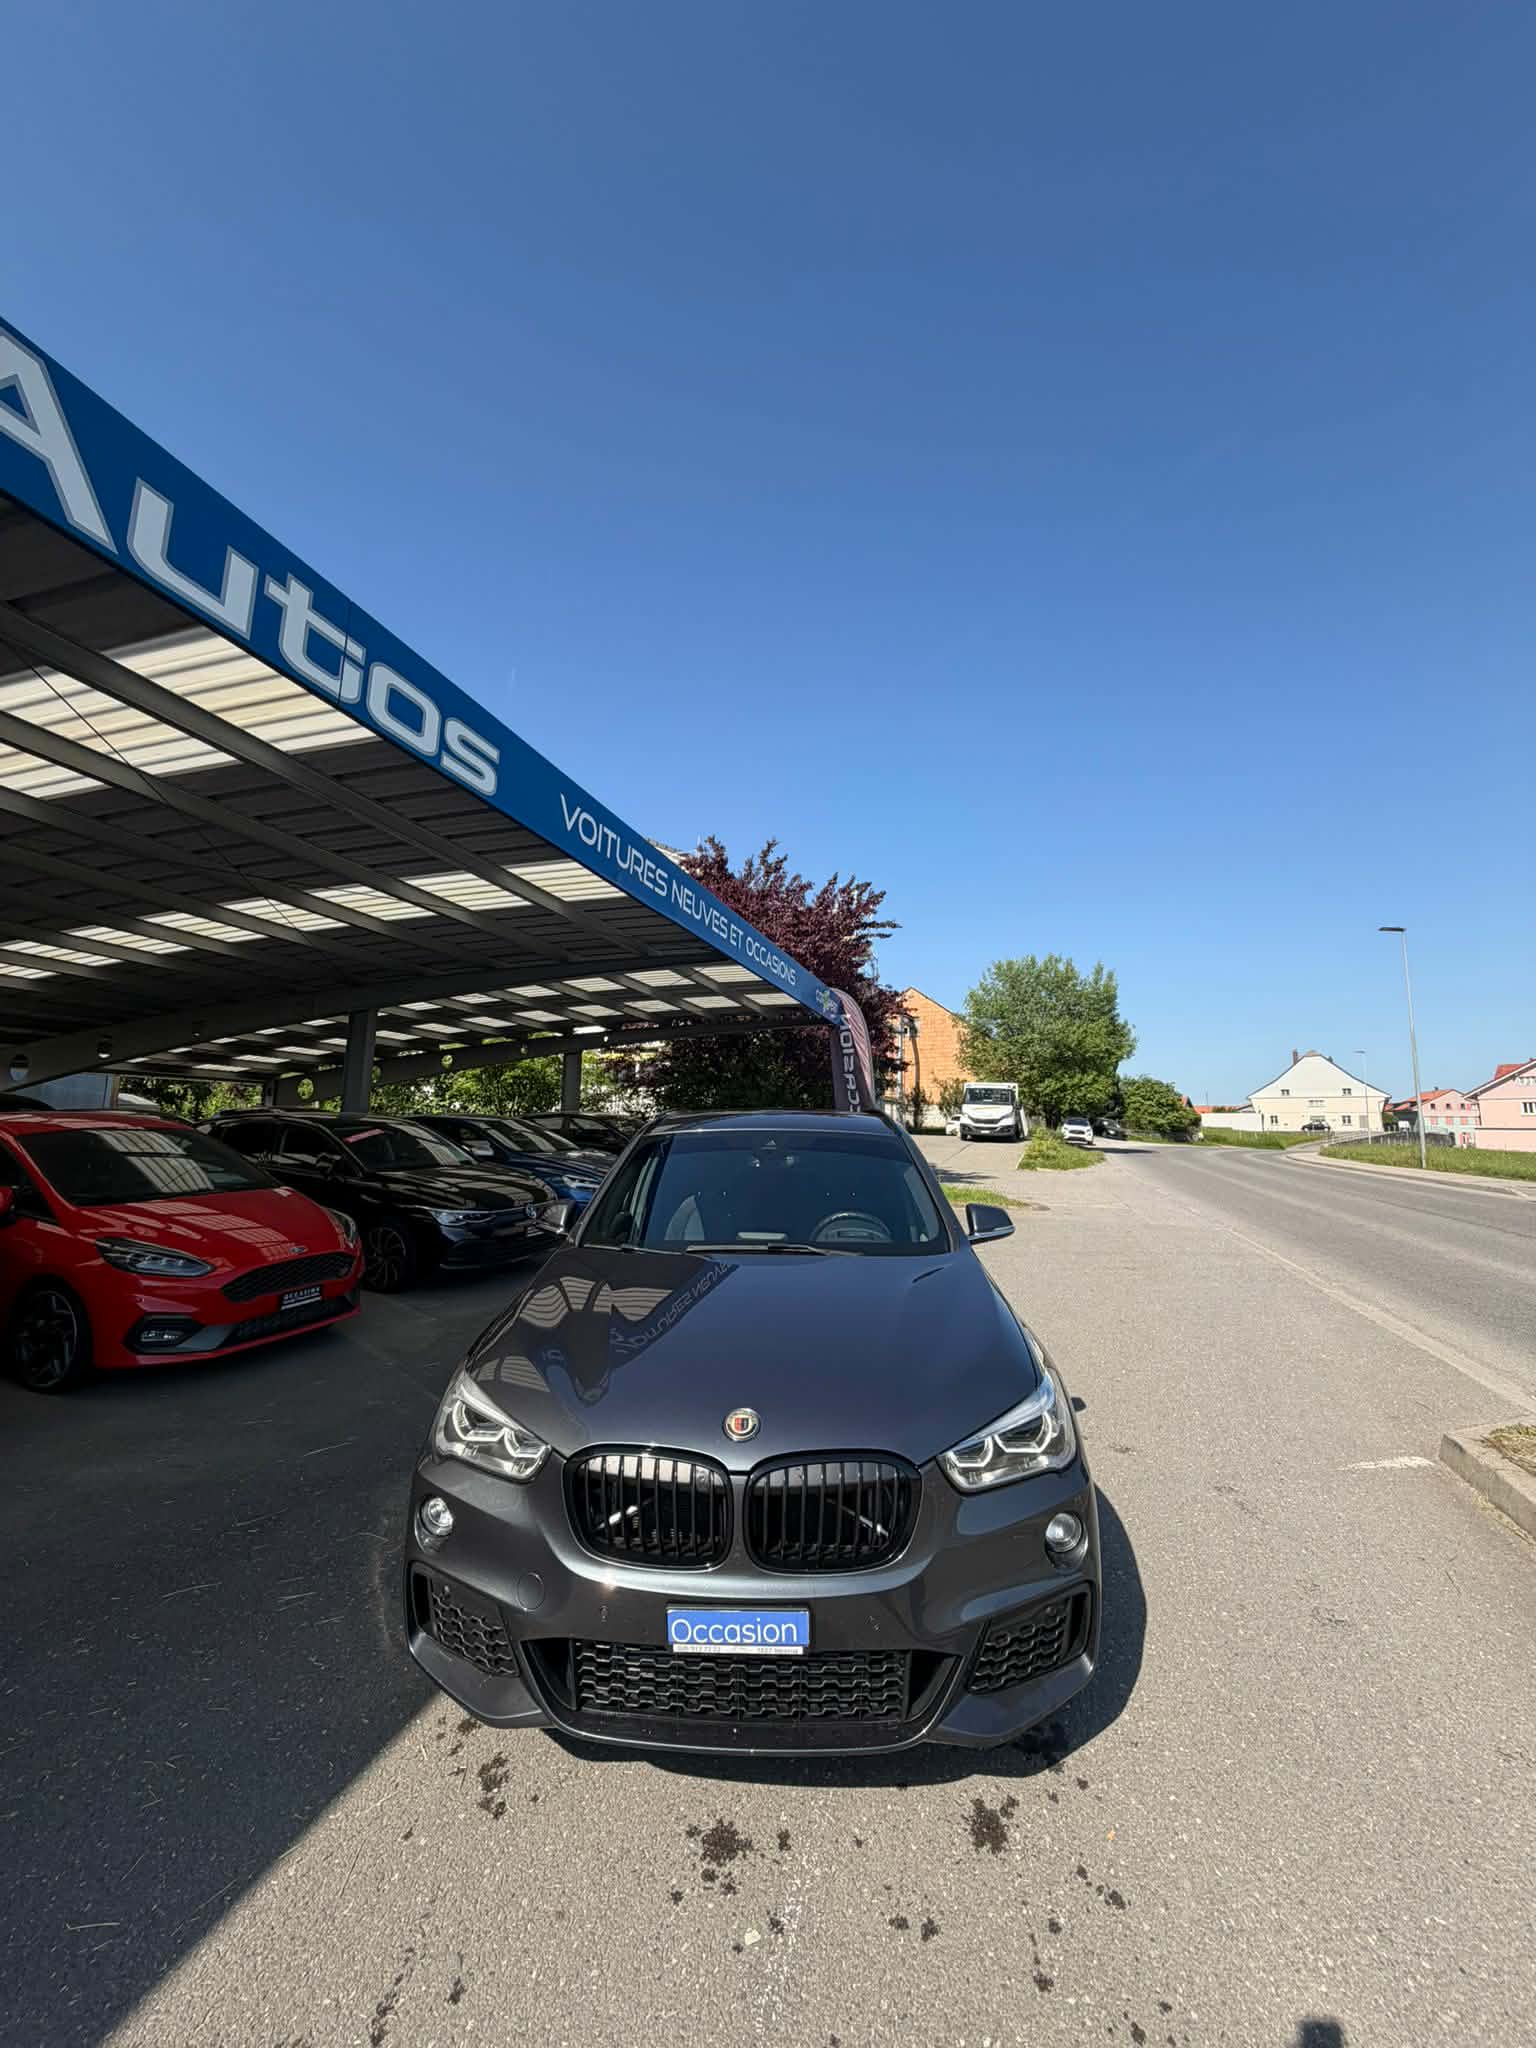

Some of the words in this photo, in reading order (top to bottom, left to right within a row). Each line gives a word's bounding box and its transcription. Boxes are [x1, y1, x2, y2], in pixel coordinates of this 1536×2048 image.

[560, 792, 669, 897] VOITURES
[671, 879, 728, 939] NEUVES
[729, 924, 744, 949] ET
[745, 937, 797, 986] OCCASIONS
[671, 1618, 797, 1644] Occasion
